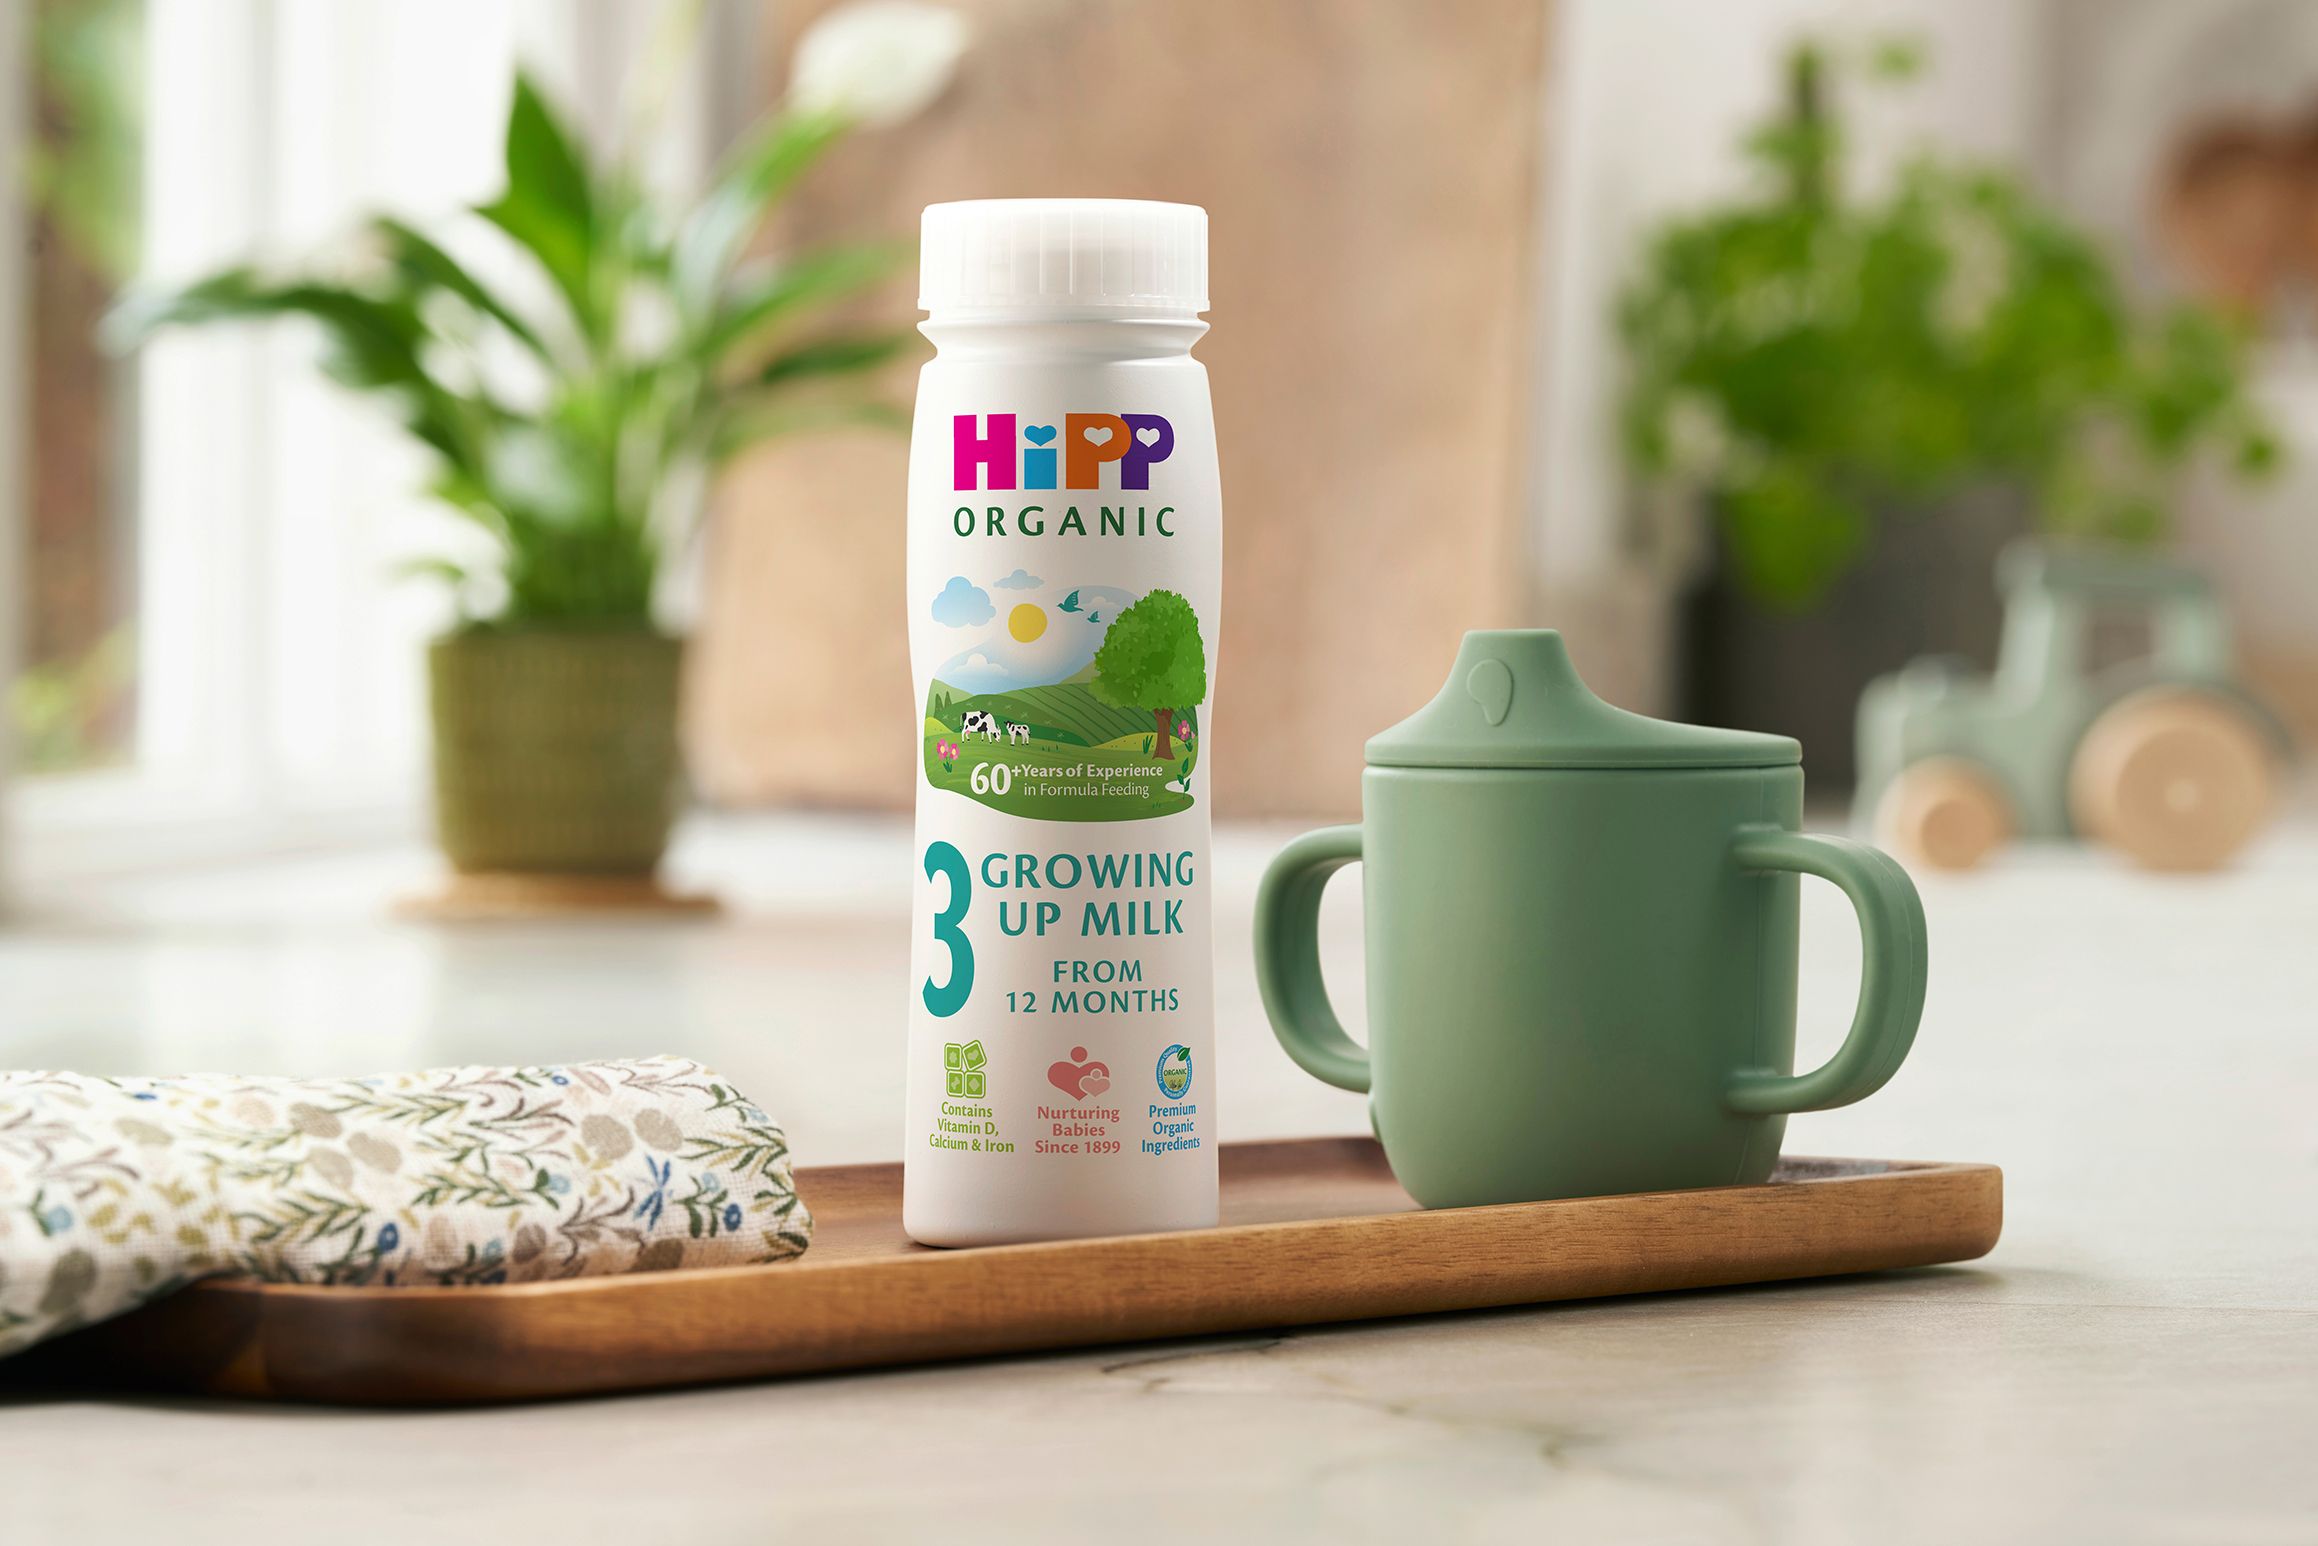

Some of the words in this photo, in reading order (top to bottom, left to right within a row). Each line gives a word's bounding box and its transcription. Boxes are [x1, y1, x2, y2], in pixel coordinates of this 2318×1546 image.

[954, 413, 1175, 490] HiPP
[953, 506, 1175, 537] ORGANIC
[1021, 764, 1063, 777] Years
[1065, 763, 1083, 777] of
[1087, 763, 1163, 780] Experience
[1024, 782, 1036, 796] in
[1040, 782, 1098, 796] Formula
[1102, 782, 1150, 798] Feeding
[981, 850, 1194, 889] GROWING
[1000, 901, 1062, 937] UP
[1081, 899, 1184, 937] MILK
[922, 841, 975, 1018] 3
[1053, 959, 1143, 983] FROM
[1006, 991, 1037, 1013] 12
[1051, 987, 1179, 1013] MONTHS
[1163, 1067, 1187, 1077] ORGANIC
[941, 1101, 993, 1118] Contains
[1036, 1105, 1121, 1123] Nurturing
[1149, 1102, 1197, 1118] Premium
[937, 1118, 980, 1134] Vitamin
[984, 1121, 999, 1137] D,
[1052, 1123, 1106, 1137] Babies
[1153, 1119, 1195, 1138] Organic
[929, 1133, 968, 1151] Calcium
[971, 1138, 981, 1152] &
[985, 1138, 1015, 1153] Iron
[1035, 1140, 1078, 1154] Since
[1084, 1140, 1121, 1154] 1899
[1141, 1137, 1201, 1156] Ingredients
